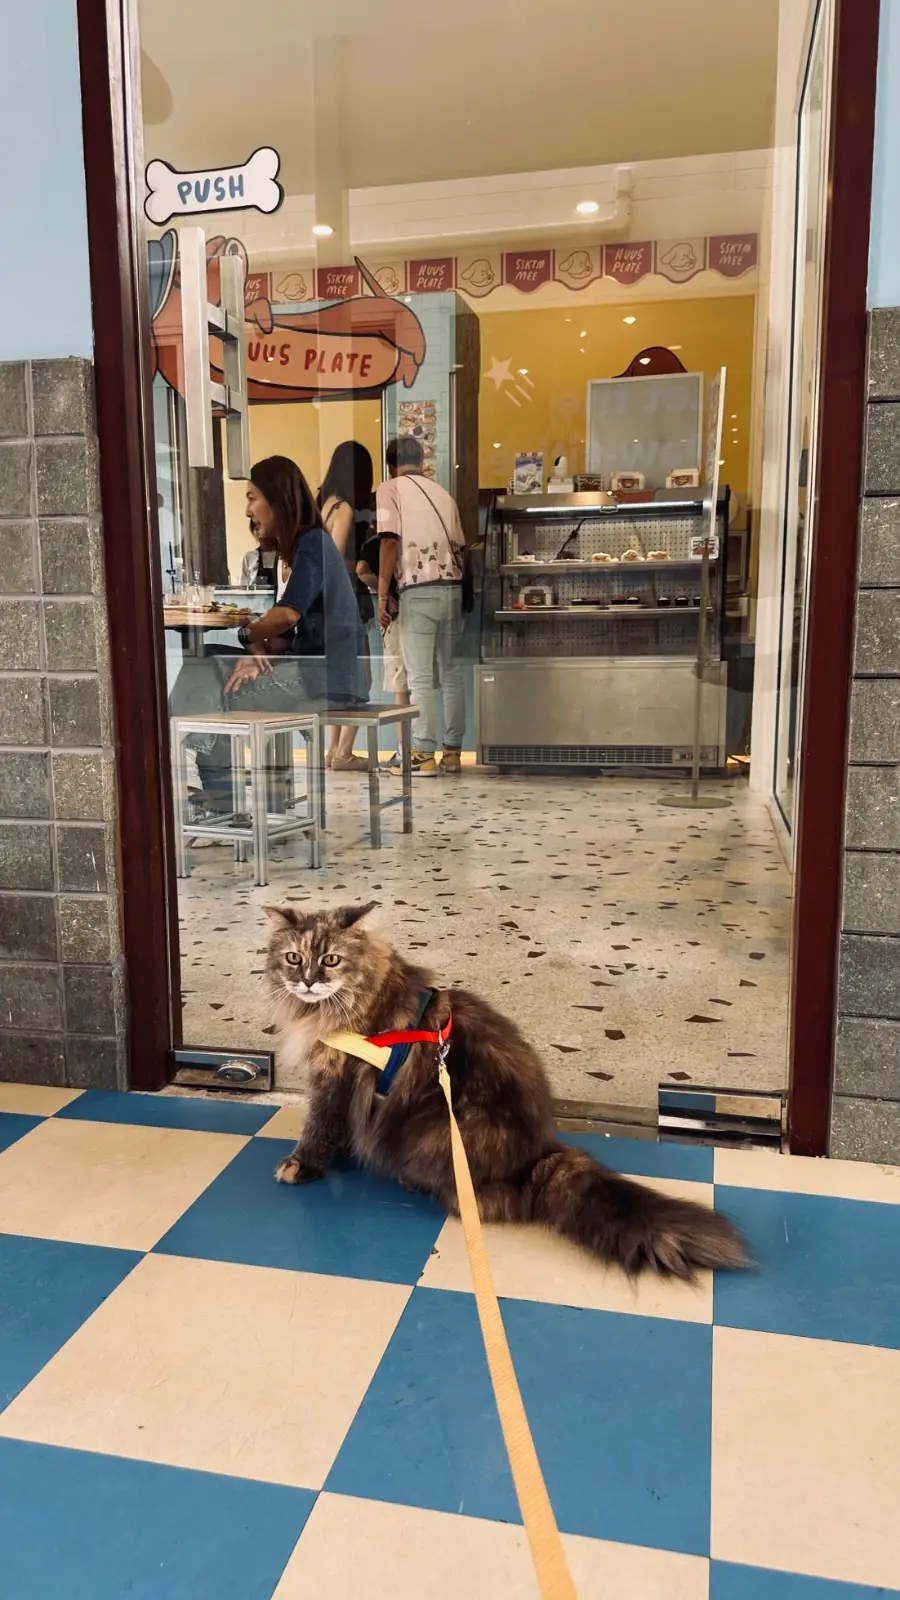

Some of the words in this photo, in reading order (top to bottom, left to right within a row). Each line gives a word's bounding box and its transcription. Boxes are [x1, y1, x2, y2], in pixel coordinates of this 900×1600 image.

[177, 174, 245, 205] PUSH
[614, 247, 644, 261] HUUS
[718, 254, 744, 266] MEE
[417, 264, 446, 276] HUUS
[612, 260, 642, 273] PLATE
[514, 270, 539, 282] MEE
[416, 277, 444, 289] PLATE
[326, 286, 348, 295] MEE
[248, 341, 292, 366] UUS
[304, 348, 373, 377] PLATE
